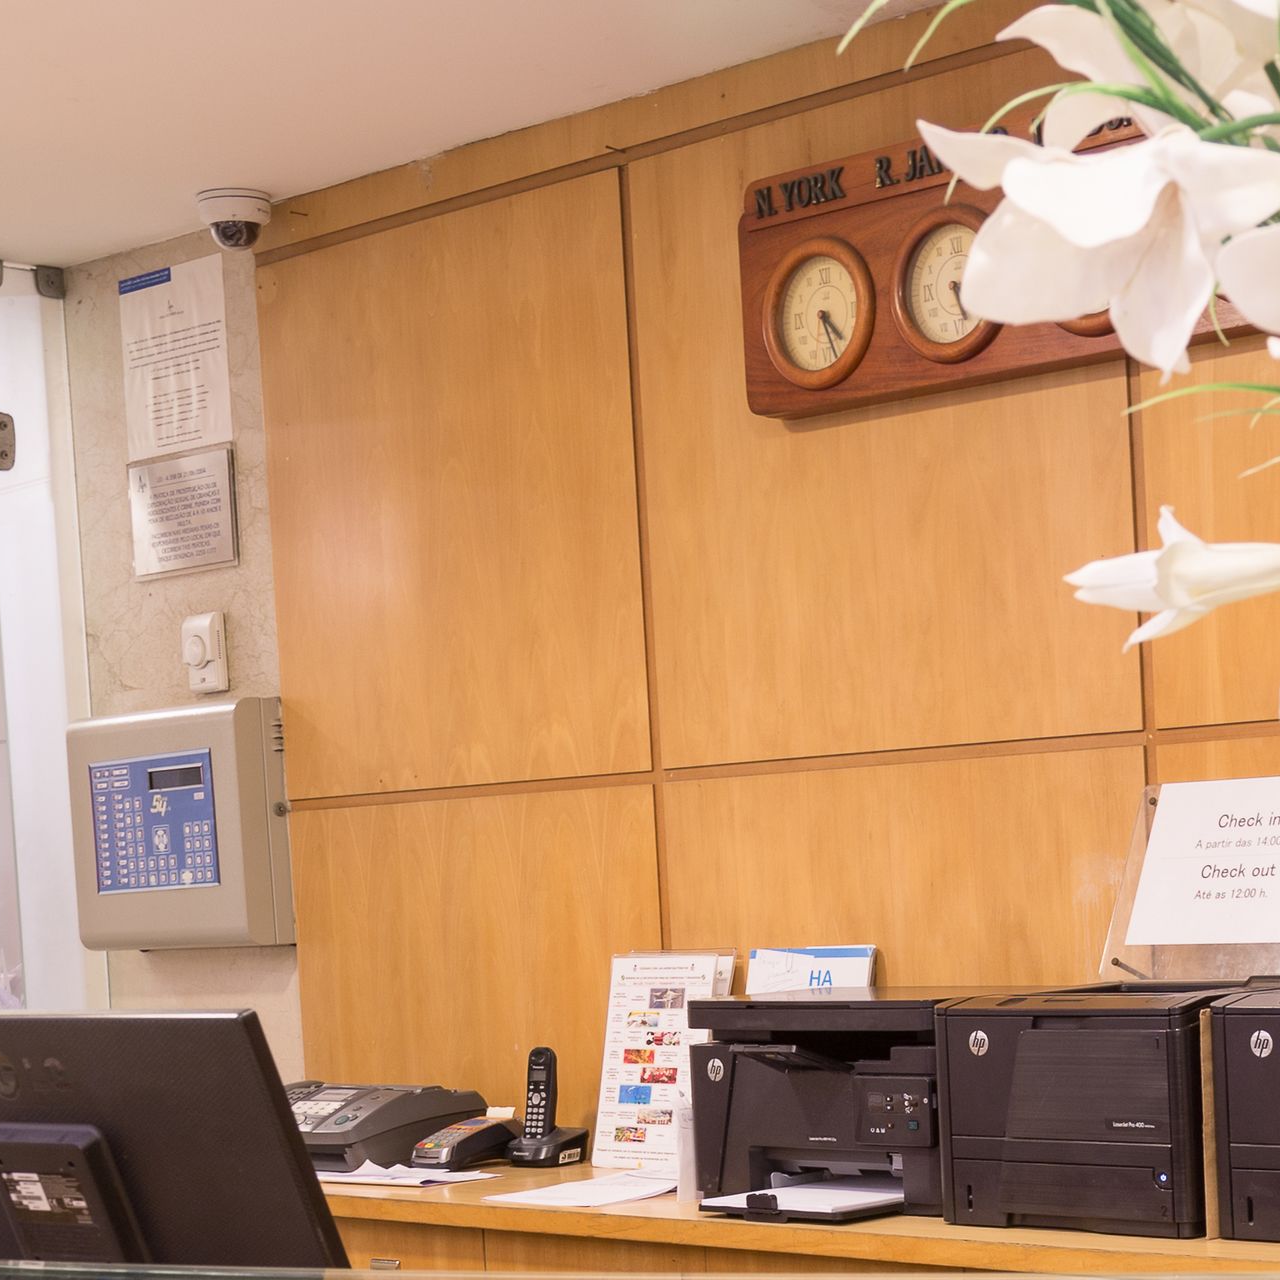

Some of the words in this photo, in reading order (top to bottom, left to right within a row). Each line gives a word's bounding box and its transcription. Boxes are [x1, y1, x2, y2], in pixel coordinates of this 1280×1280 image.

[875, 155, 900, 188] R.
[778, 166, 847, 212] YORK
[1218, 812, 1263, 828] Check
[1269, 811, 1280, 826] in
[1195, 839, 1202, 849] A
[1205, 837, 1232, 850] partir
[1235, 838, 1252, 848] das
[1201, 863, 1245, 879] Check
[1252, 863, 1276, 877] out
[1194, 889, 1211, 900] Até
[809, 970, 832, 986] HA
